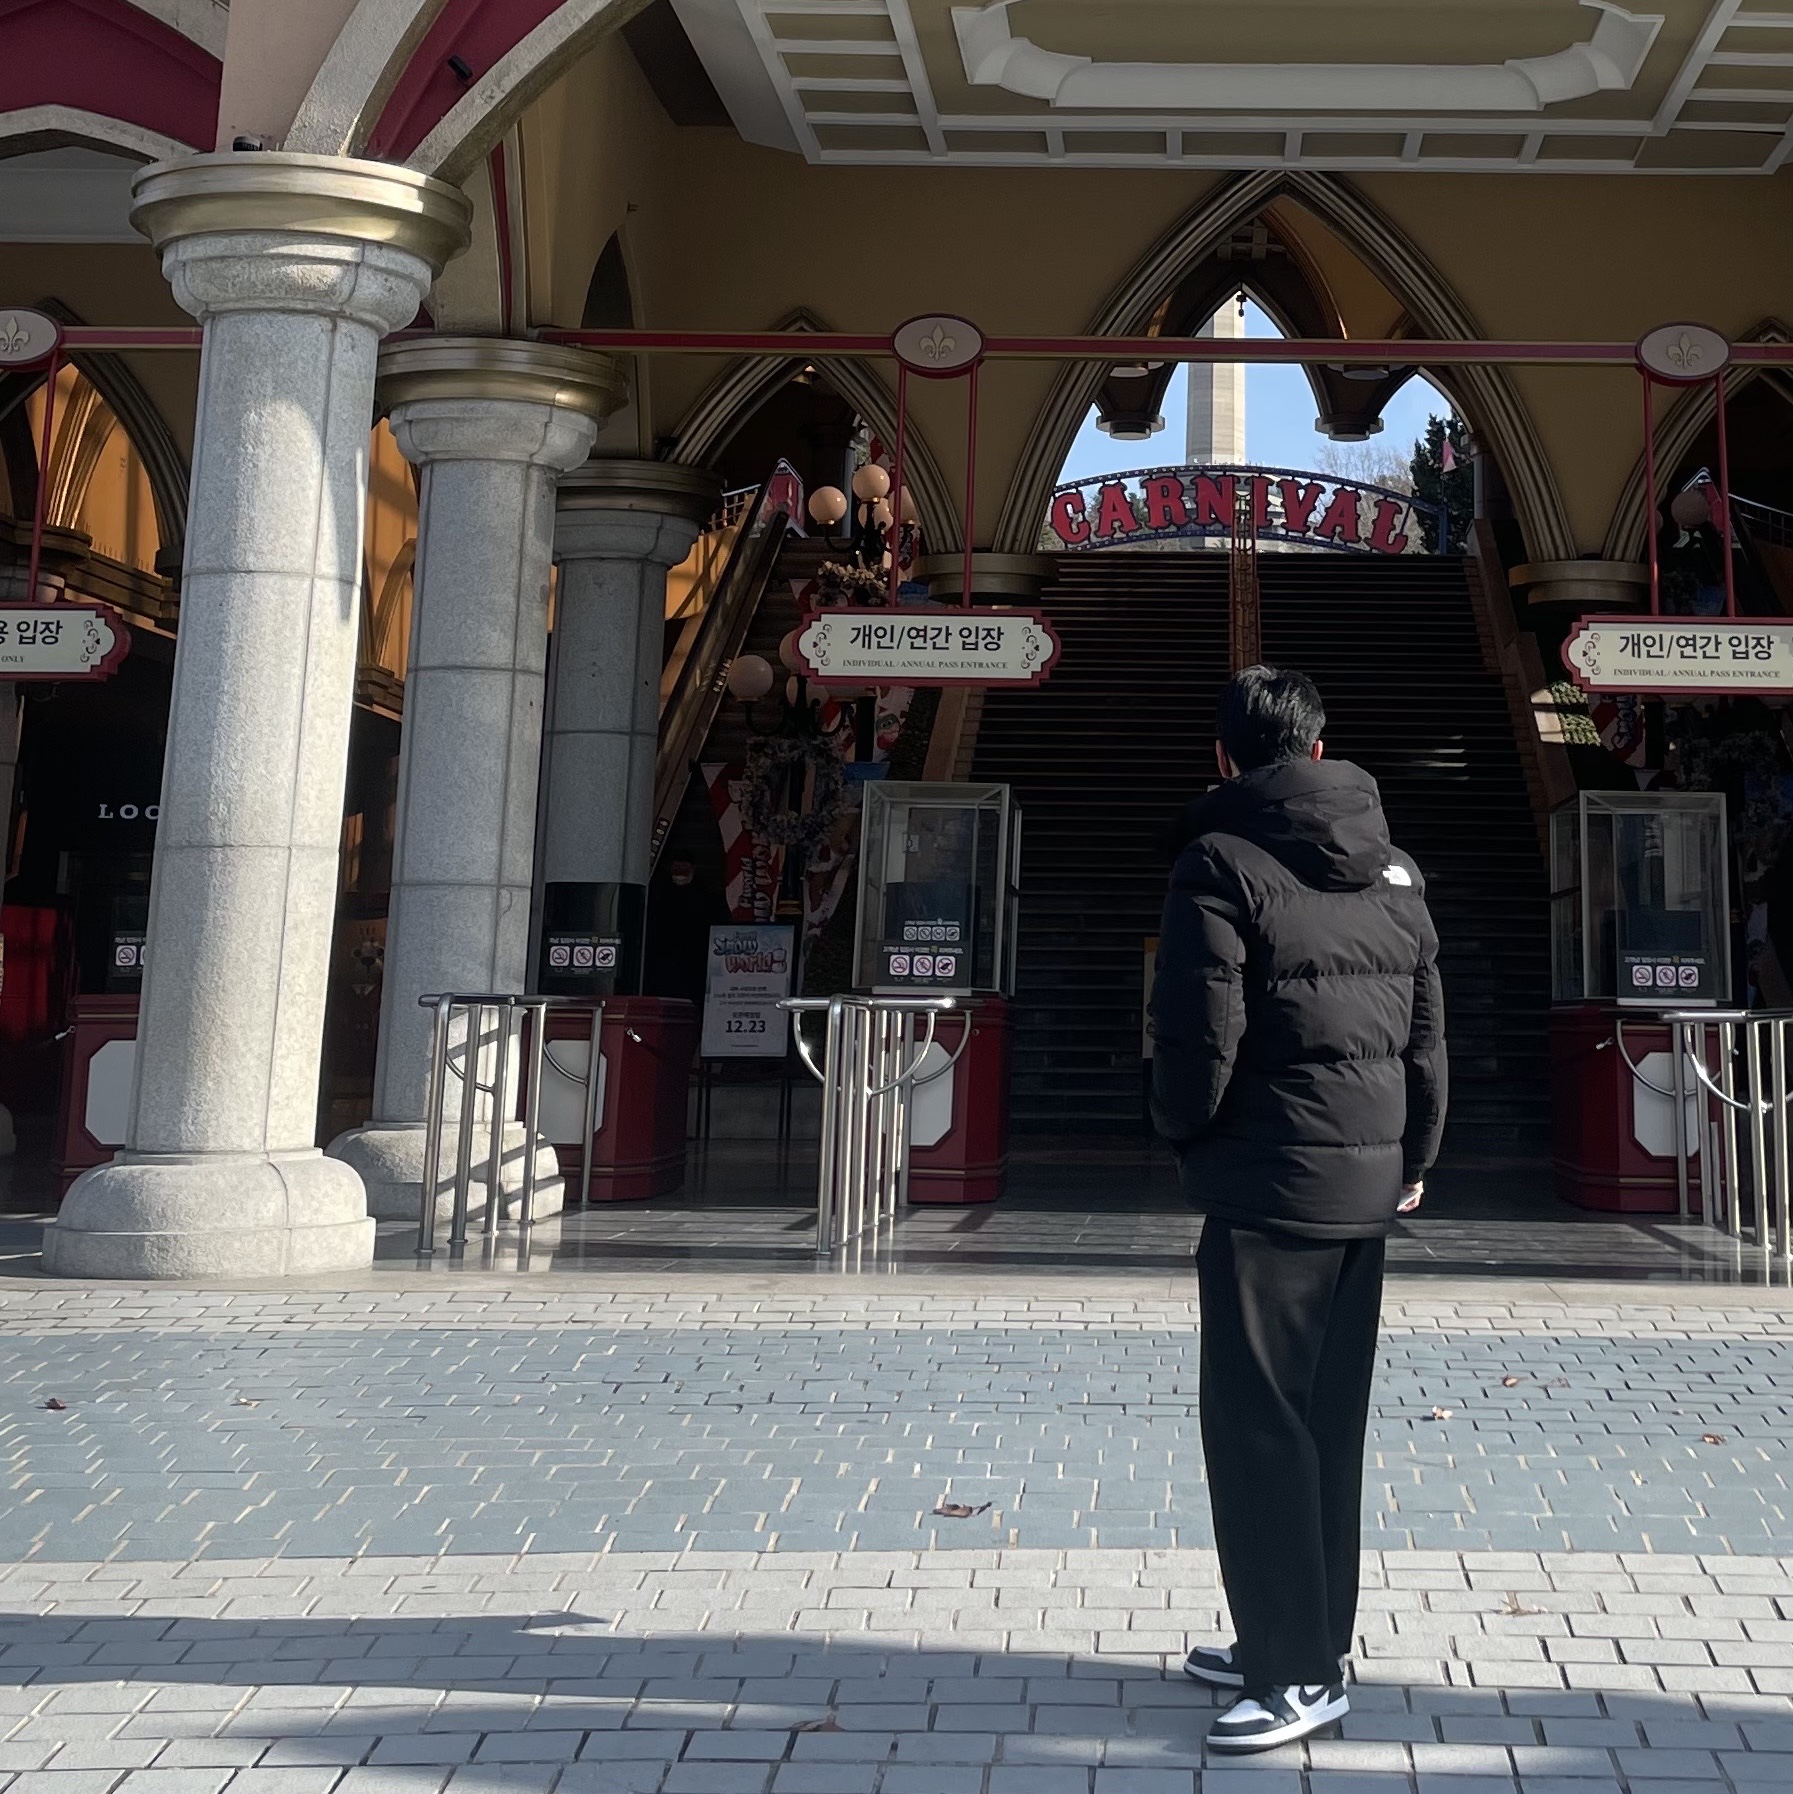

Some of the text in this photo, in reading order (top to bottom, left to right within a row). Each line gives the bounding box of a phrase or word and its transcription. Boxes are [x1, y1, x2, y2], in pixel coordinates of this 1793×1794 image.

[1051, 473, 1408, 554] CARNIVAL
[16, 619, 64, 645] 입장
[849, 624, 1005, 651] 개인/연간 입장
[1619, 633, 1774, 660] 개인/연간 입장
[0, 655, 24, 663] ONLY
[842, 659, 895, 668] INDIVIDUAL
[900, 660, 936, 668] ANNUAL
[960, 661, 1008, 669] ENTRANCE
[1613, 668, 1666, 677] INDIVIDUAL
[1672, 669, 1709, 678] ANNUAL
[1710, 670, 1731, 678] PASS
[1732, 670, 1781, 678] ENTRANCE
[725, 1019, 766, 1033] 12.23
